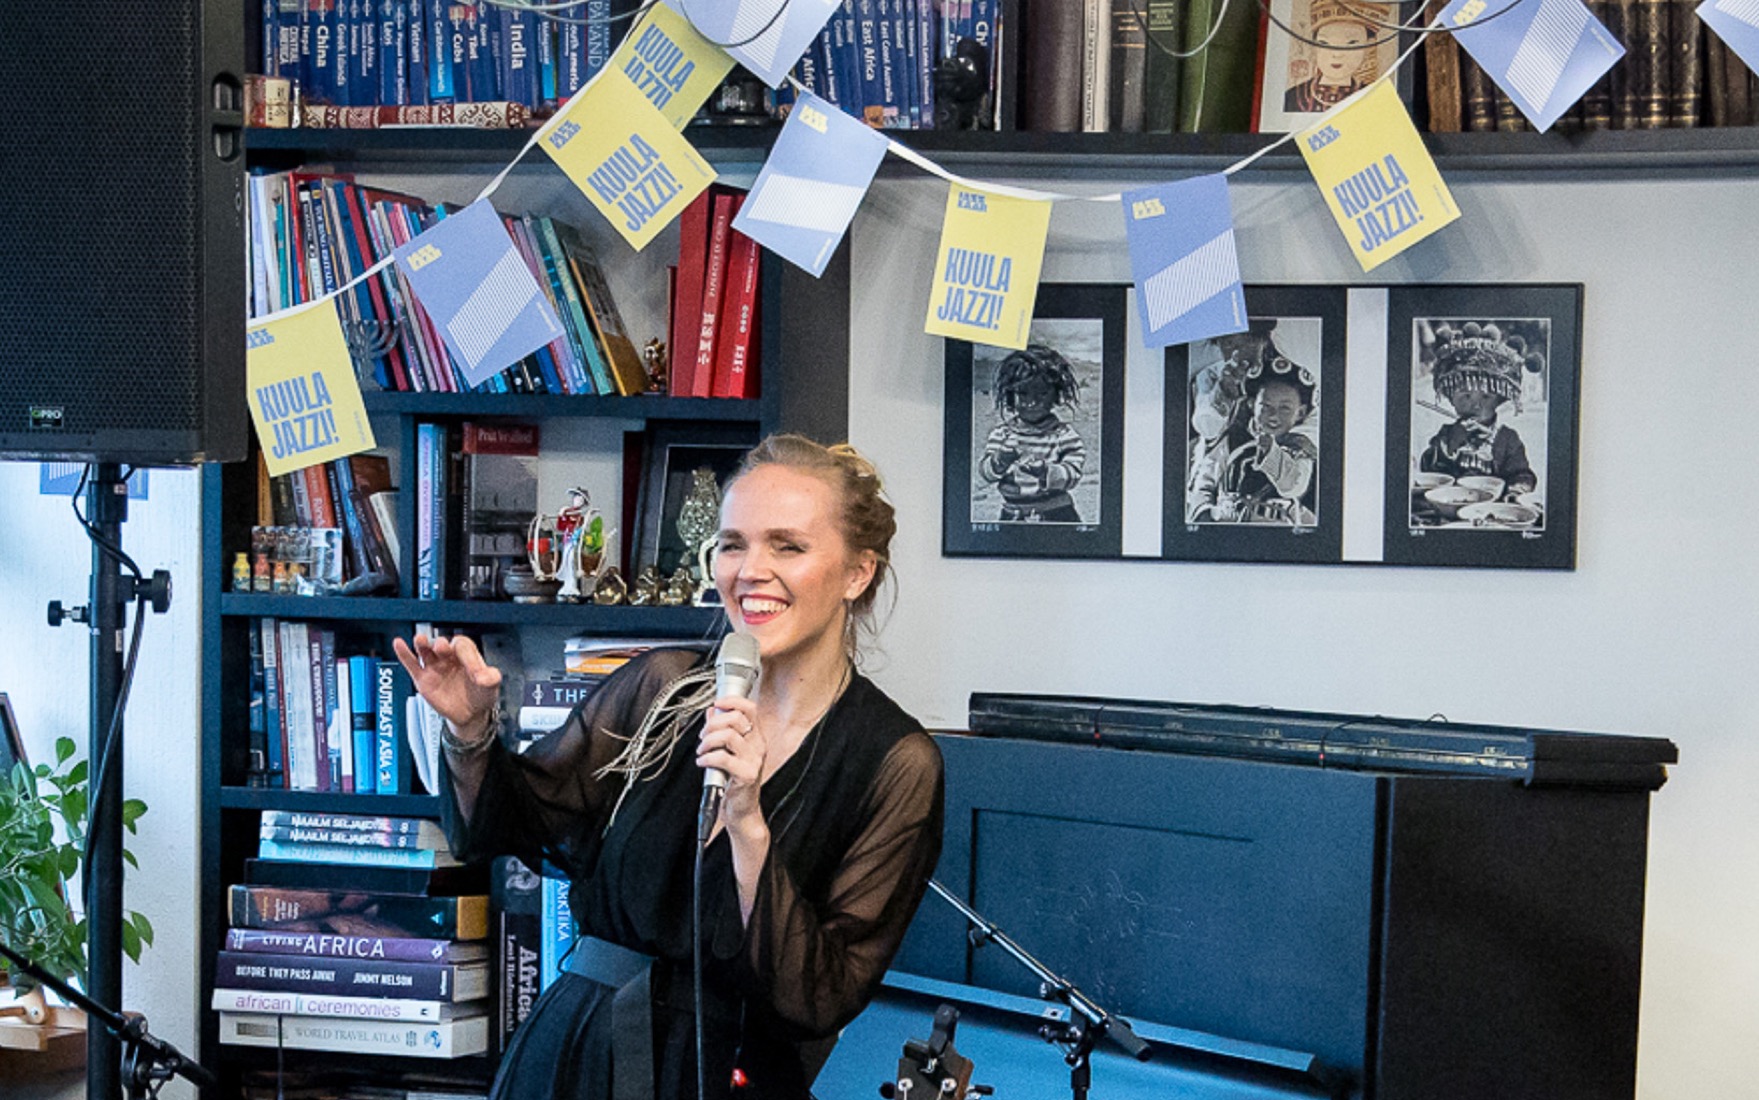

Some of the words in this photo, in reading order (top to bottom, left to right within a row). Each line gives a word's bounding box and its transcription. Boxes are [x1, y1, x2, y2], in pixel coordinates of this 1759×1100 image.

[301, 26, 310, 55] Nepal
[317, 25, 328, 67] China
[337, 24, 346, 51] Greek
[384, 21, 394, 45] Laos
[411, 22, 421, 62] Vietnam
[435, 21, 443, 62] Caribbean
[453, 34, 464, 63] Cuba
[469, 36, 479, 59] Tibet
[479, 24, 487, 47] Korea
[511, 24, 526, 69] India
[861, 20, 874, 45] East
[880, 21, 890, 40] East
[337, 54, 346, 86] Islands
[569, 52, 579, 91] america
[633, 22, 696, 94] KUULA
[863, 47, 876, 81] Africa
[883, 66, 893, 103] Australia
[585, 133, 661, 205] KUULA
[1333, 152, 1409, 220] KUULA
[616, 161, 685, 234] JAZZI!
[1356, 188, 1424, 252] JAZZI!
[944, 247, 1012, 292] KUULA
[938, 287, 1005, 331] JAZZI!
[255, 371, 332, 423] KUULA
[272, 408, 340, 460] JAZZI!
[379, 667, 393, 737] SOUTHEAST
[380, 739, 393, 768] ASIA
[303, 935, 385, 958] AFRICA
[507, 935, 515, 961] Leni
[236, 966, 267, 978] BEFORE
[269, 967, 290, 979] THEY
[289, 968, 311, 980] PASS
[313, 969, 336, 982] AWAY
[353, 972, 380, 984] JIMMY
[381, 974, 413, 986] NELSON
[517, 946, 537, 1023] Africa
[235, 994, 291, 1011] african
[307, 998, 401, 1017] ceremonies
[295, 1026, 333, 1039] WORLD
[334, 1028, 369, 1041] TRAVEL
[372, 1031, 401, 1043] ATLAS
